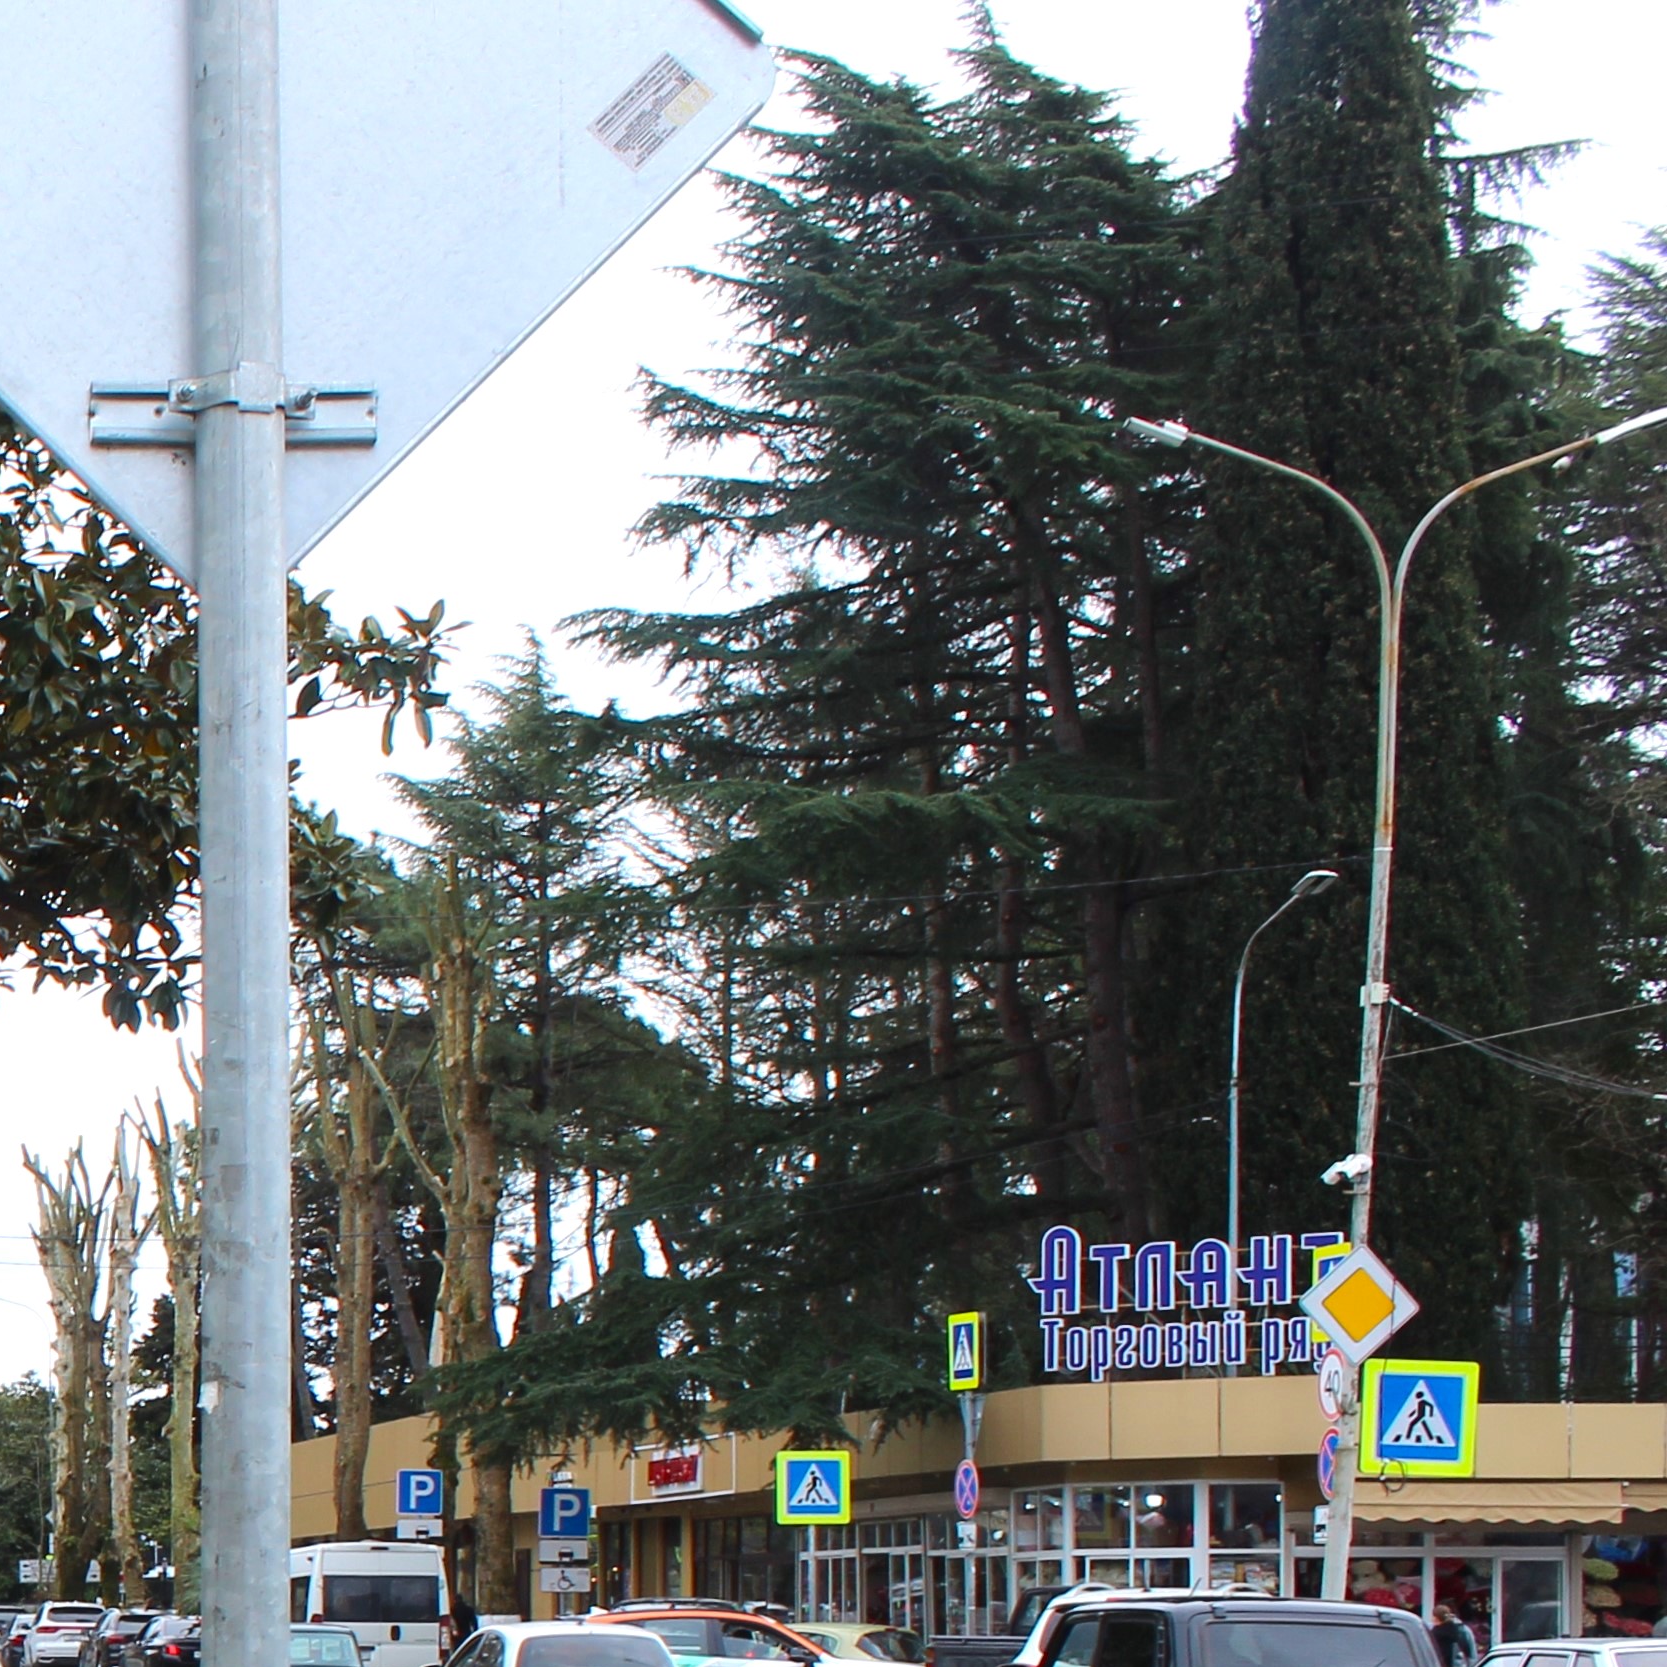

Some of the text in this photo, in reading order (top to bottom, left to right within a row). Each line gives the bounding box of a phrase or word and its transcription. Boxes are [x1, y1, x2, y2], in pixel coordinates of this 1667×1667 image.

[1040, 1310, 1334, 1382] Торговый ря
[1324, 1369, 1340, 1397] 40
[409, 1474, 435, 1510] P
[552, 1493, 581, 1532] P
